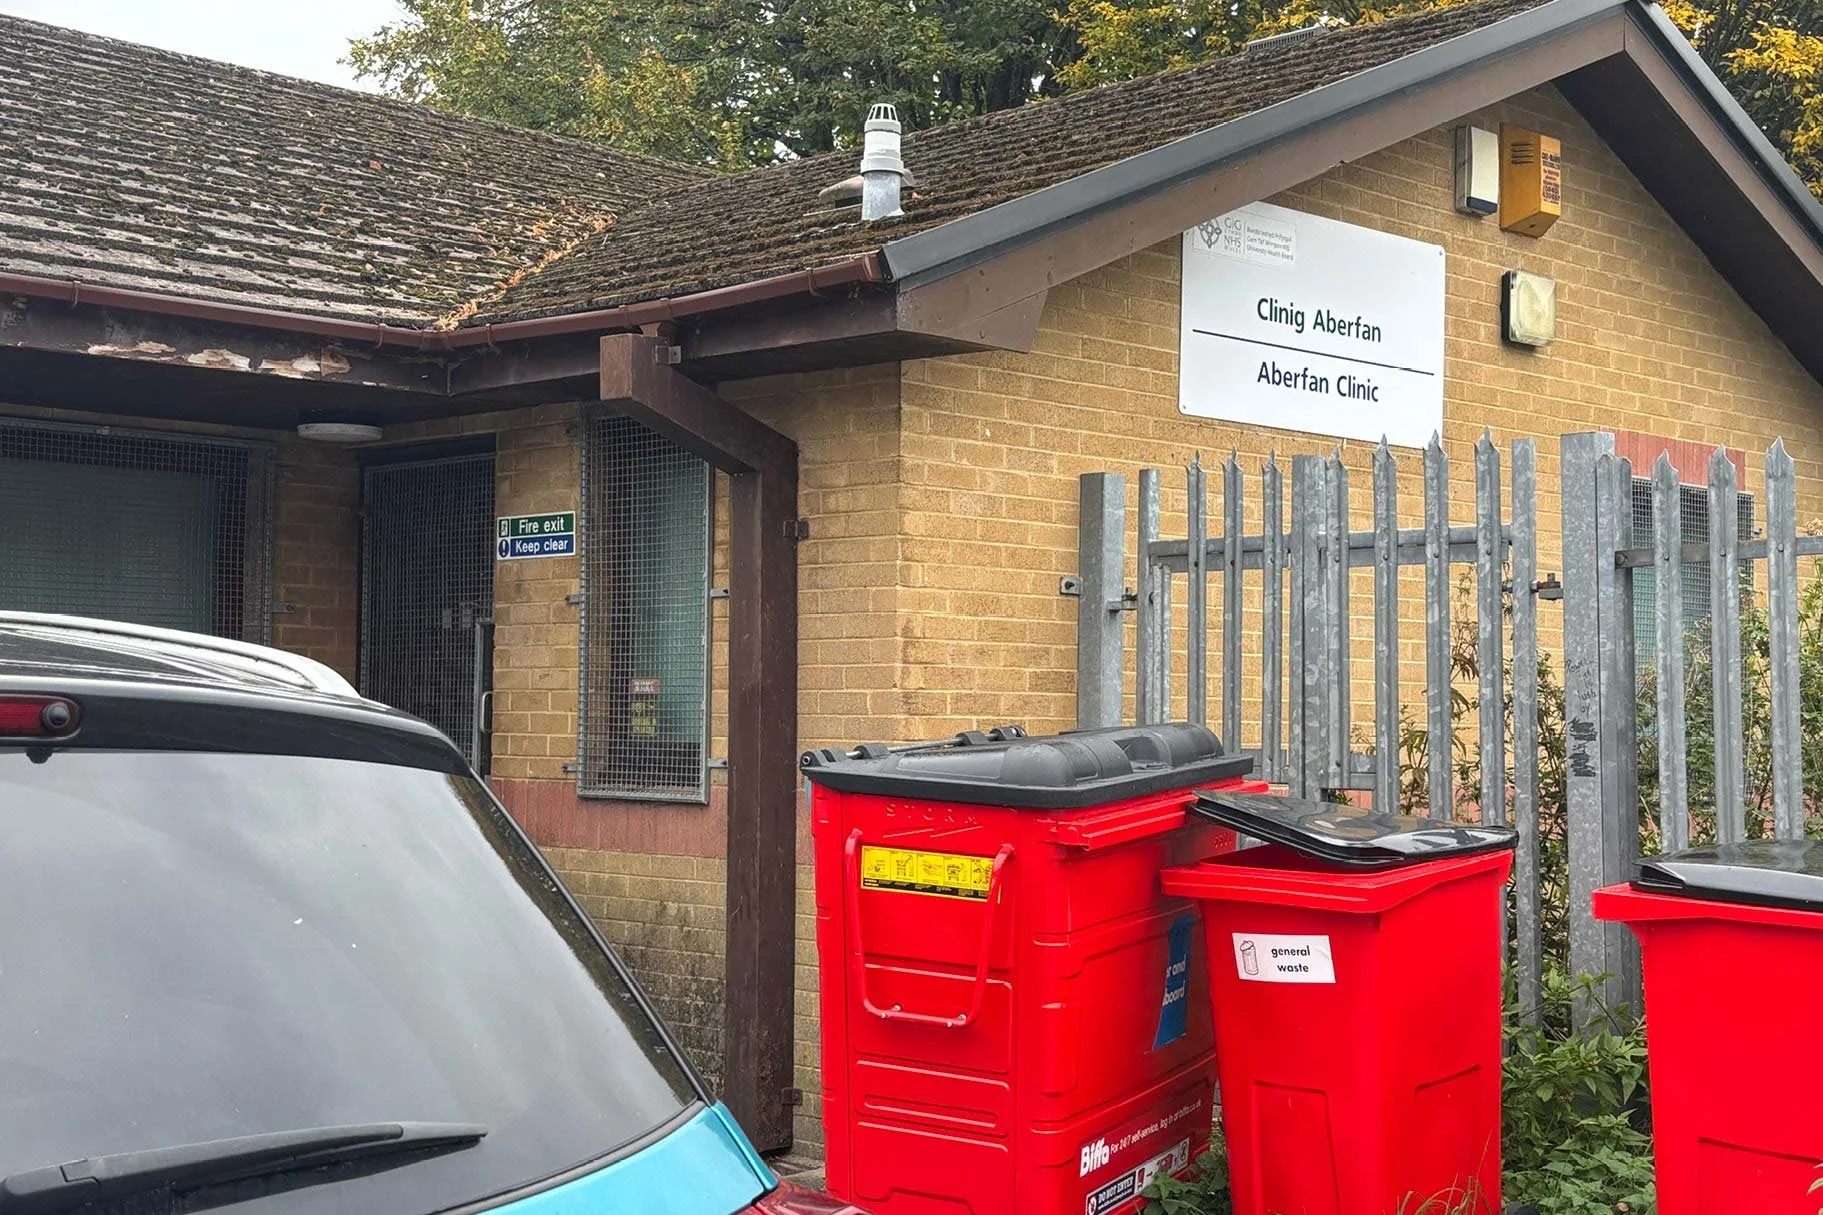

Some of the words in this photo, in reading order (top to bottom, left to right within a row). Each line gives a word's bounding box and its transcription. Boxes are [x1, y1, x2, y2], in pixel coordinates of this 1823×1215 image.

[1224, 235, 1242, 249] NHS
[1257, 298, 1305, 334] Clinig
[1312, 309, 1381, 343] Aberfan
[1257, 361, 1329, 394] Aberfan
[1336, 375, 1379, 402] Clinic
[519, 519, 539, 534] Fire
[543, 516, 565, 532] exit
[515, 540, 540, 554] Keep
[543, 538, 568, 551] clear
[1271, 945, 1311, 958] general
[1172, 953, 1186, 976] and
[1277, 963, 1310, 973] waste
[1080, 1137, 1110, 1177] Biffa
[1110, 1142, 1119, 1154] For
[1119, 1134, 1131, 1150] 24/7
[1098, 1191, 1107, 1203] DO
[1106, 1184, 1117, 1198] NOT
